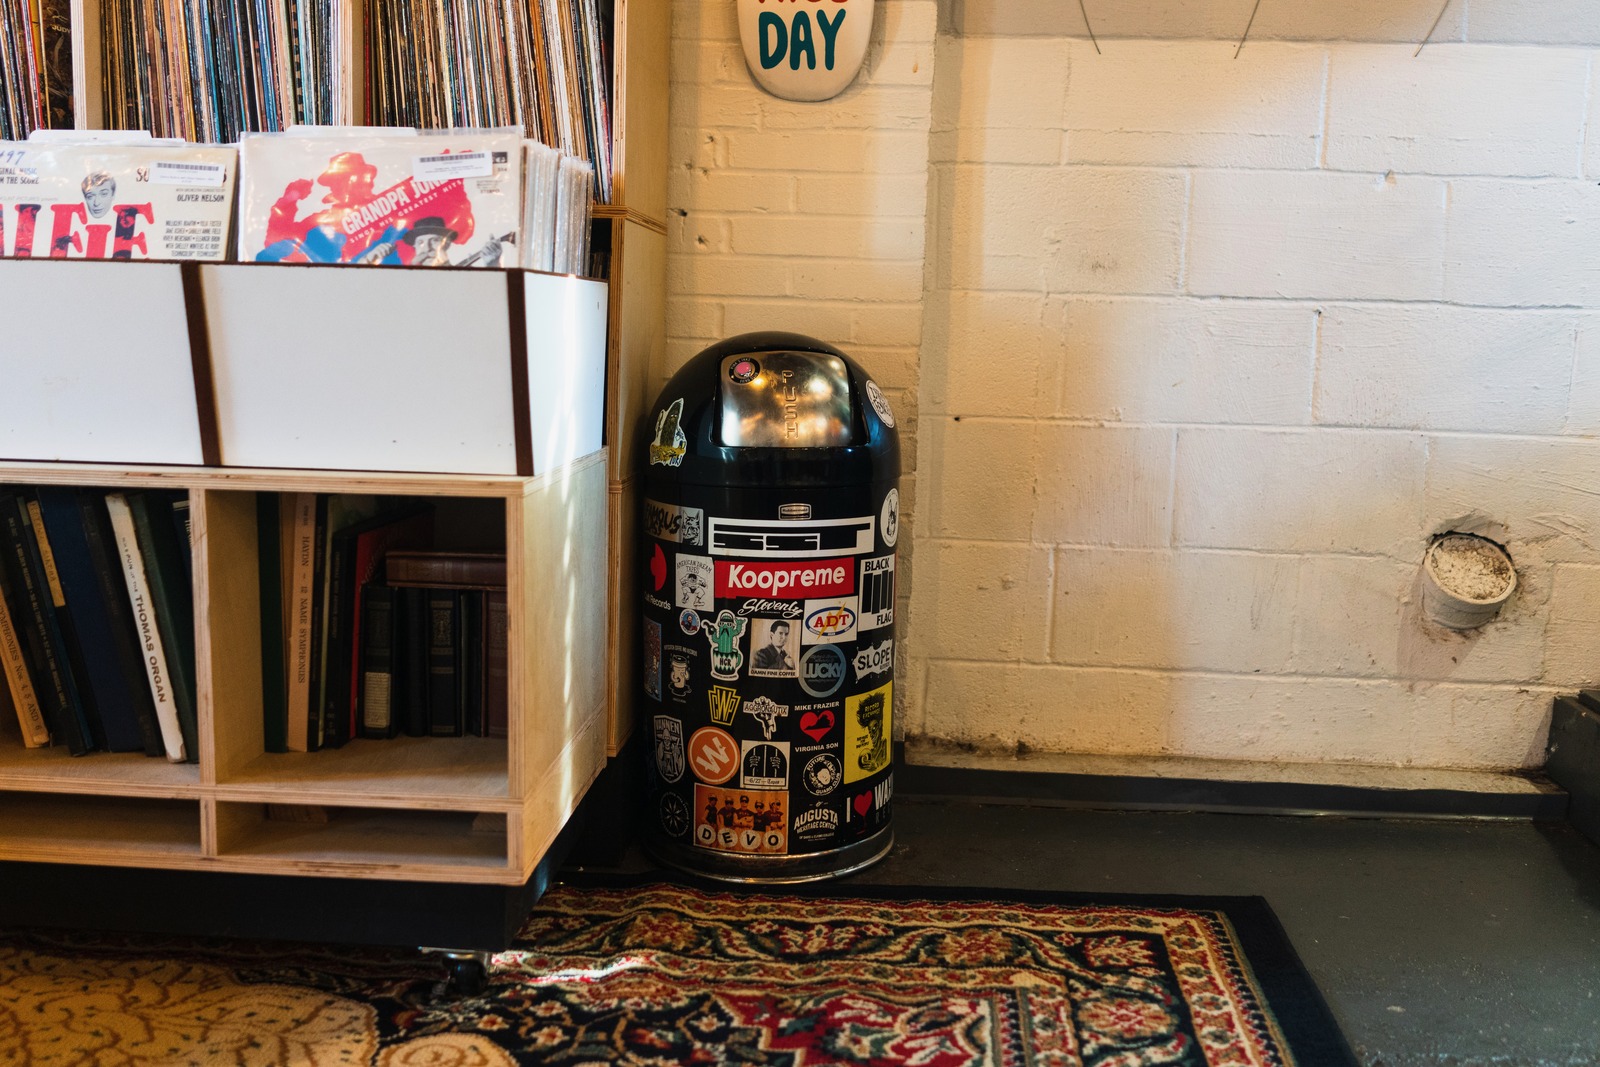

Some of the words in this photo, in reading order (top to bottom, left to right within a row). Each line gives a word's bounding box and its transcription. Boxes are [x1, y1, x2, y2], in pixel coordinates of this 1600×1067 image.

[758, 8, 847, 70] DAY
[7, 176, 19, 185] THE
[177, 194, 199, 202] OLIVER
[201, 194, 225, 203] NELSON
[341, 184, 411, 235] GRANDPA
[349, 228, 376, 244] SINGS
[379, 216, 394, 228] HIS
[398, 191, 438, 218] GREATEST
[442, 179, 463, 193] HITS
[301, 536, 311, 568] HAYDN
[677, 559, 697, 570] AMERICAN
[864, 557, 891, 572] BLACK
[728, 564, 846, 597] Koopreme
[299, 598, 308, 626] NAME
[738, 599, 804, 618] Slovenly
[813, 613, 850, 628] ADT
[876, 611, 893, 627] FLAG
[135, 595, 155, 652] THOMAS
[149, 656, 167, 704] ORGAN
[297, 629, 308, 684] SYMPHONIES
[857, 646, 891, 671] SLOPE
[719, 657, 732, 667] HCR
[803, 662, 842, 679] LUCKY
[750, 669, 767, 677] DAMN
[27, 702, 40, 722] AND
[813, 701, 840, 710] FRAZIER
[794, 744, 825, 753] VIRGINIA
[825, 742, 840, 750] SON
[806, 755, 826, 771] FUTURE
[846, 796, 852, 823] I
[793, 808, 840, 831] AUGUSTA
[796, 821, 819, 834] HERITAGE
[819, 821, 836, 831] CENTER
[701, 827, 779, 846] DEVO
